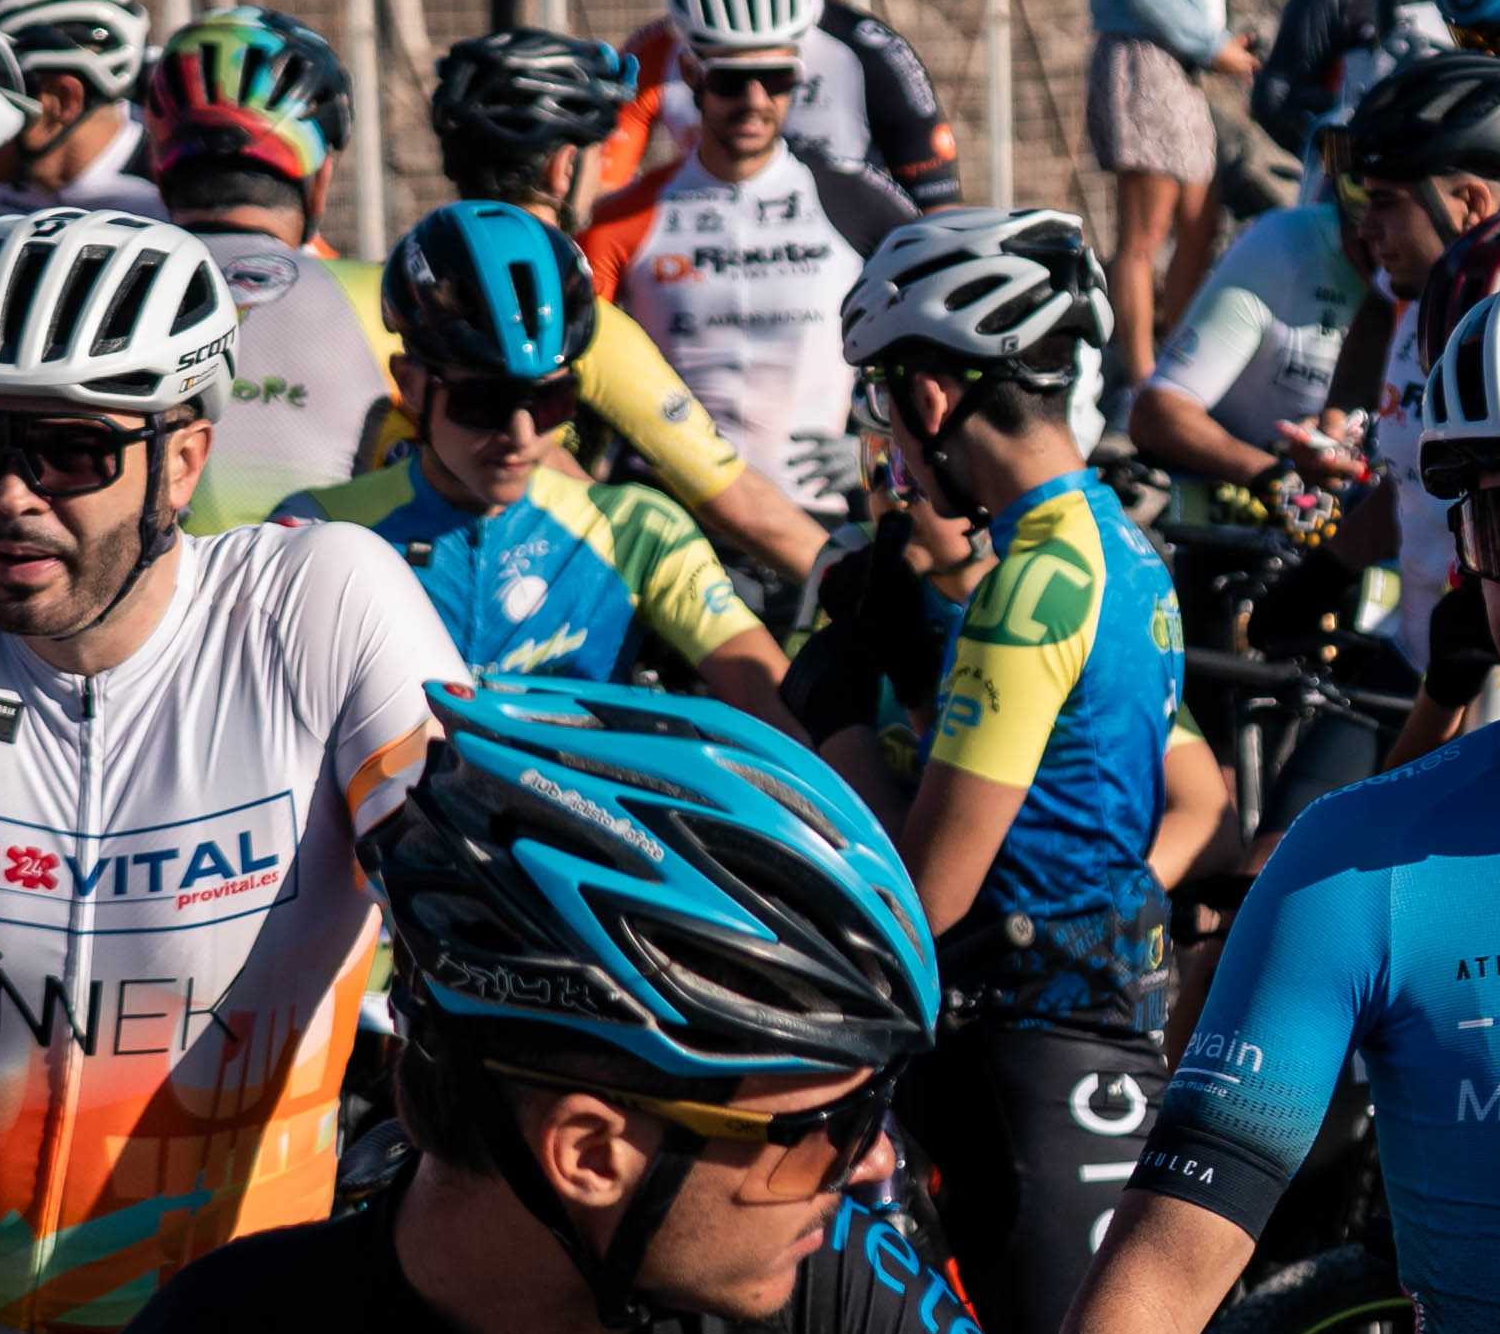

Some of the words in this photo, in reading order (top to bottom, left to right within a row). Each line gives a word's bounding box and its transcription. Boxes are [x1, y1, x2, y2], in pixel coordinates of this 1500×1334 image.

[176, 325, 236, 373] SCOTT
[19, 855, 43, 877] 24
[176, 869, 280, 911] provital.es
